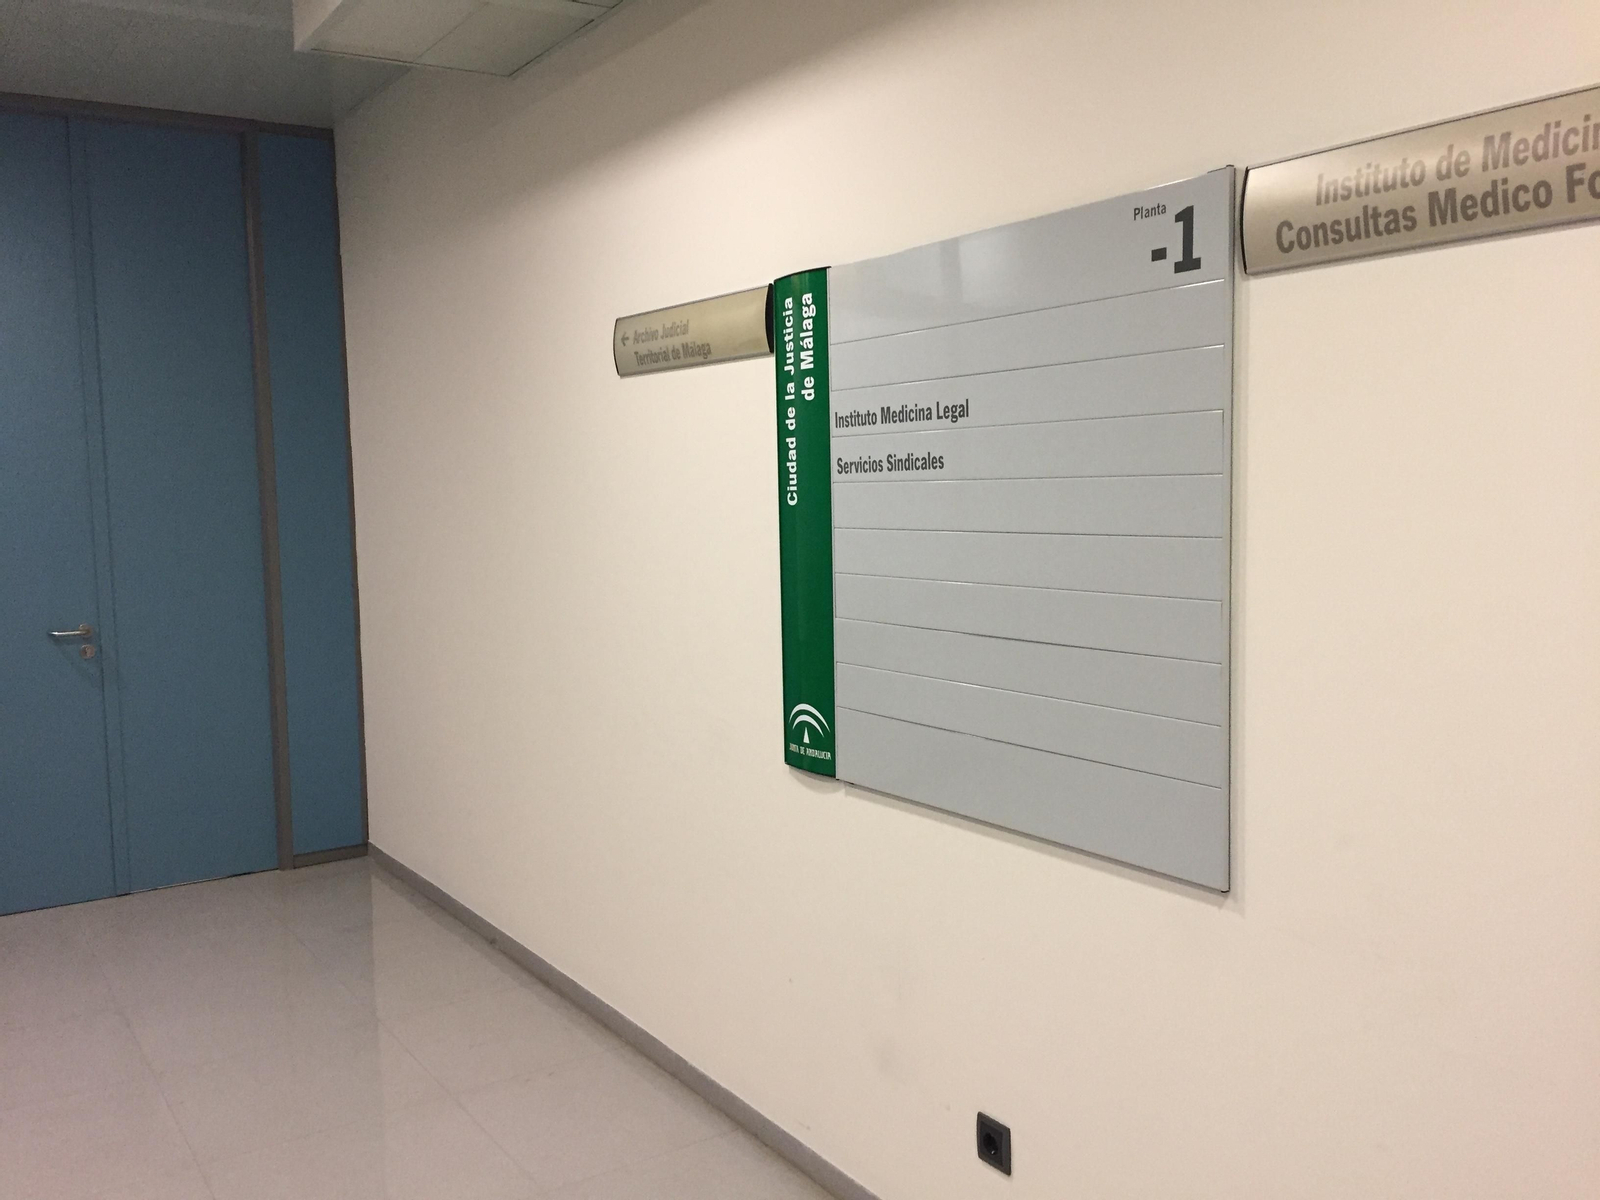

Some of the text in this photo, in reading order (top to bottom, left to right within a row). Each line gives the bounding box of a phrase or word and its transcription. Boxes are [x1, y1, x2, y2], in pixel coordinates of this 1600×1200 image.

[1316, 157, 1427, 206] Instituto
[1435, 144, 1471, 182] de
[1134, 203, 1167, 220] Planta
[1276, 205, 1417, 254] Consultas
[1428, 177, 1553, 227] Medico
[1151, 205, 1202, 274] -1
[633, 319, 689, 344] Archivo Judicial
[634, 341, 712, 366] Territorial de Málaga
[800, 292, 816, 400] de Málaga
[783, 297, 798, 506] Ciudad de la Justicia
[835, 398, 969, 429] Instituto Medicina Legal
[836, 452, 945, 474] Servicios Sindicales
